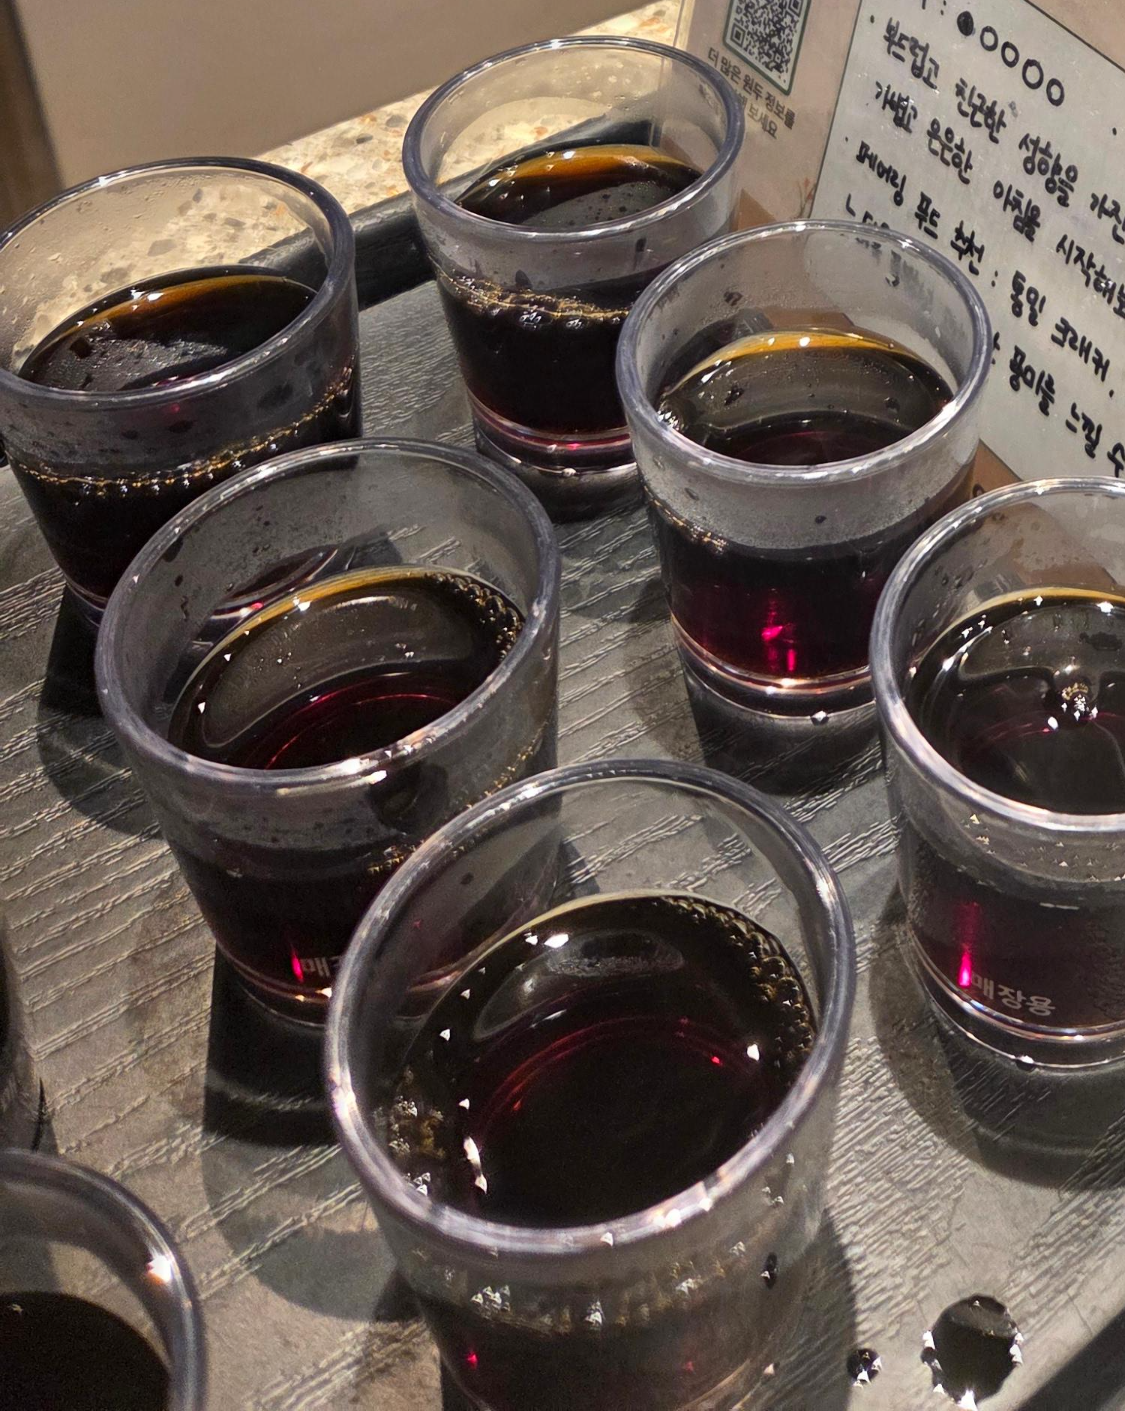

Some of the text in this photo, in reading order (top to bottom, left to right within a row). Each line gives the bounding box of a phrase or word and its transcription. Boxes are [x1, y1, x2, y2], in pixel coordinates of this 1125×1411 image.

[708, 47, 719, 68] 더
[720, 56, 742, 85] 많은
[743, 74, 763, 100] 원두
[765, 92, 796, 130] 정보를
[748, 103, 778, 139] 보세요
[883, 17, 940, 89] 부드럽고
[955, 78, 1007, 144] 친근한
[1018, 133, 1078, 207] 성향을
[856, 140, 907, 206] 페어링
[914, 191, 941, 239] 푸드
[993, 180, 1041, 242] 아침을
[1010, 270, 1046, 326] 통밀
[1009, 345, 1055, 416] 풍미를
[1065, 402, 1102, 459] 느낄
[972, 972, 1056, 1017] 매장용
